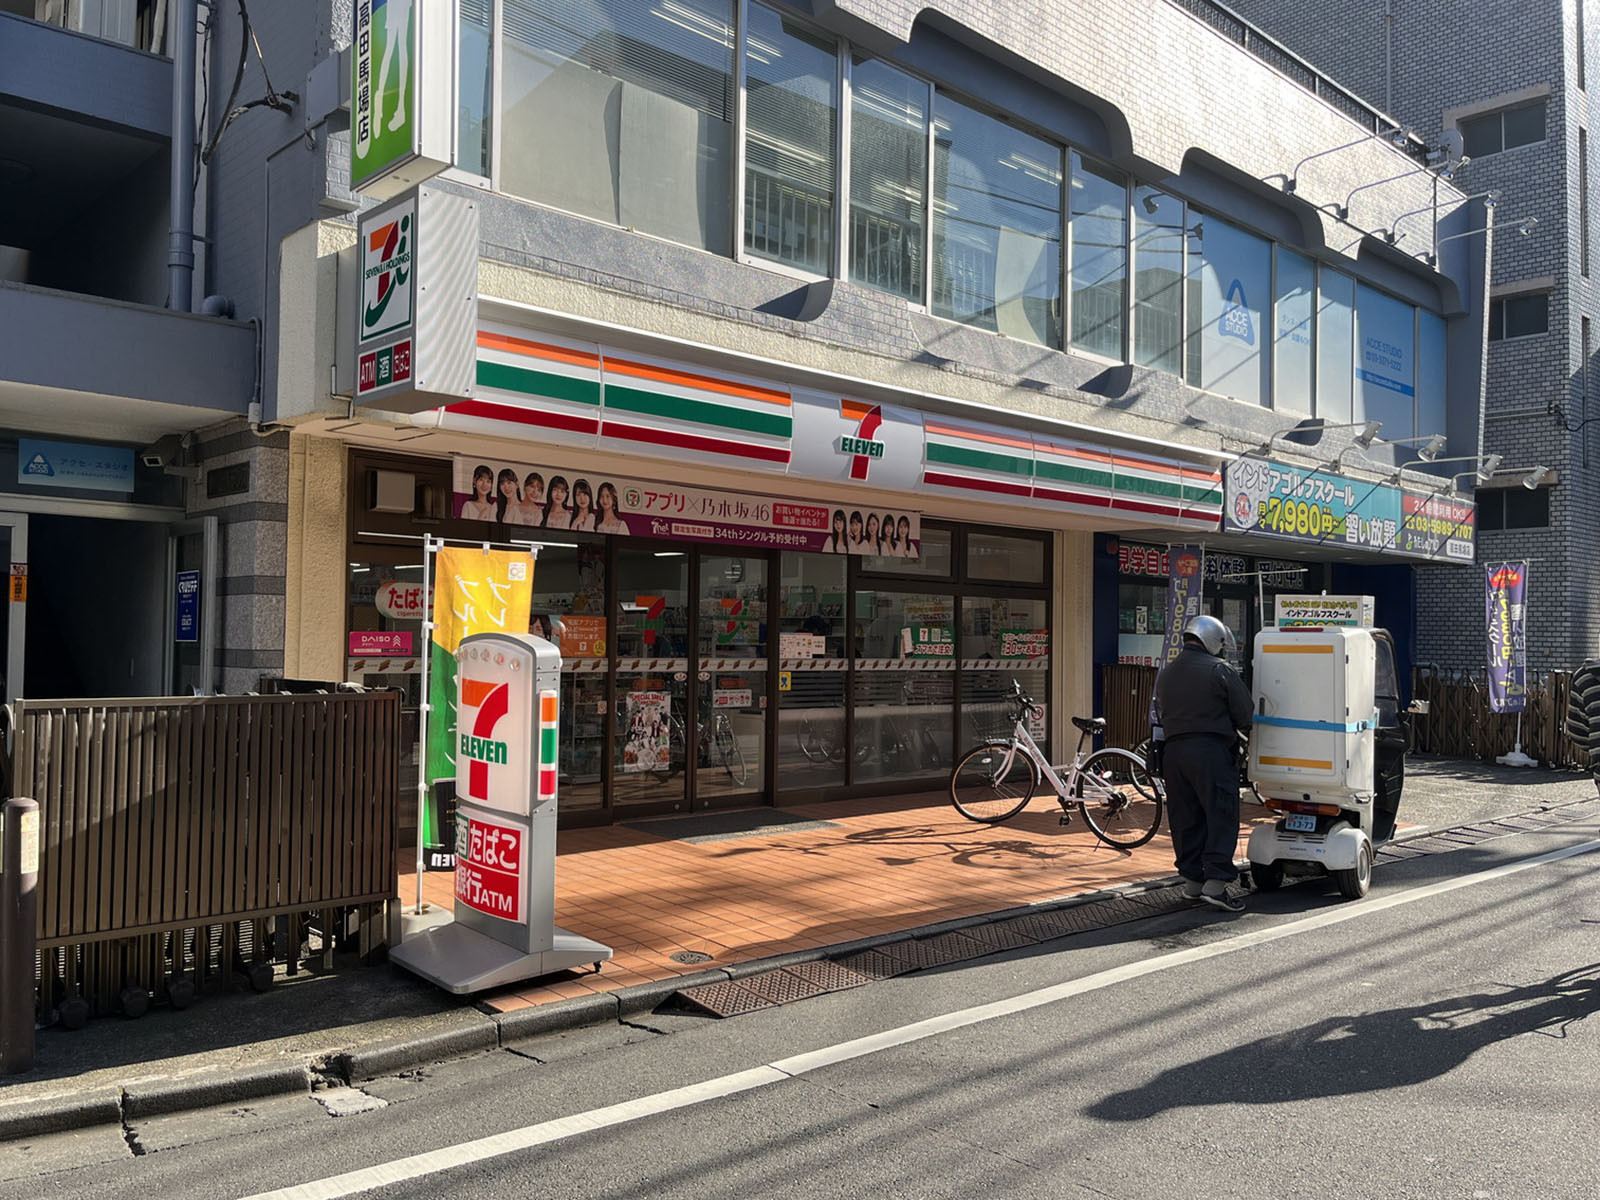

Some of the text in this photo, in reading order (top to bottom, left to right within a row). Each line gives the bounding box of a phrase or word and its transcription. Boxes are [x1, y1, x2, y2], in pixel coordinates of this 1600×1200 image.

[1225, 307, 1248, 326] ACCE
[1225, 320, 1247, 337] STUDIO
[360, 360, 376, 385] ATM
[379, 355, 390, 380] 酒
[1233, 461, 1355, 507] インドアゴルフスクール
[1345, 512, 1397, 549] 習い放題
[1286, 609, 1352, 618] インドアゴルフスクール
[469, 823, 517, 869] たばこ
